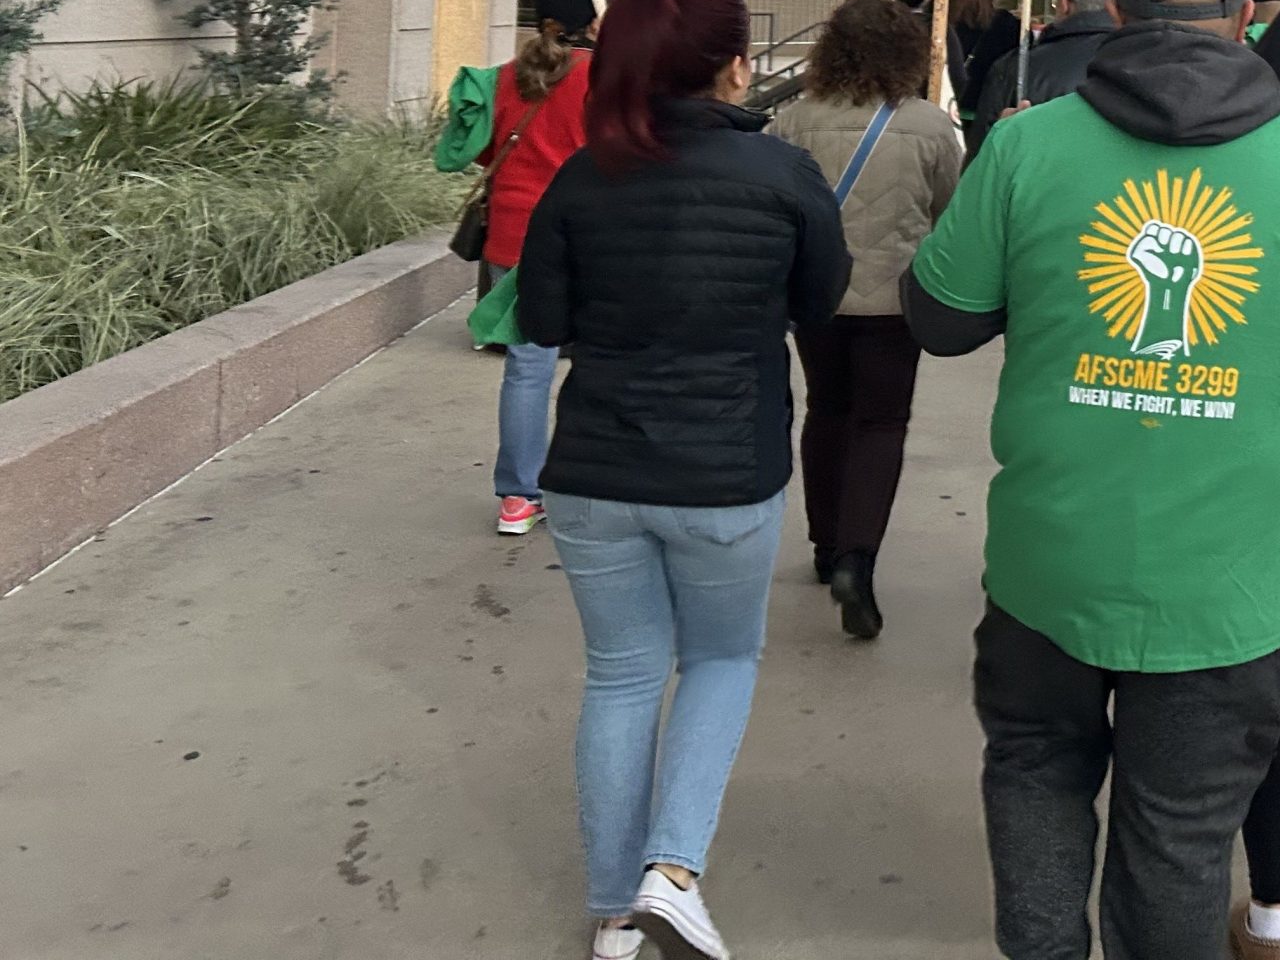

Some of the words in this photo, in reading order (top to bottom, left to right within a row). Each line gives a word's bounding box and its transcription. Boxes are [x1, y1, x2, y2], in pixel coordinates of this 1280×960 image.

[1074, 353, 1171, 392] AFSCME
[1175, 363, 1239, 397] 3299
[1069, 385, 1109, 407] WHEN
[1111, 391, 1133, 410] WE
[1180, 398, 1202, 417] WE
[1204, 400, 1236, 419] WIN!
